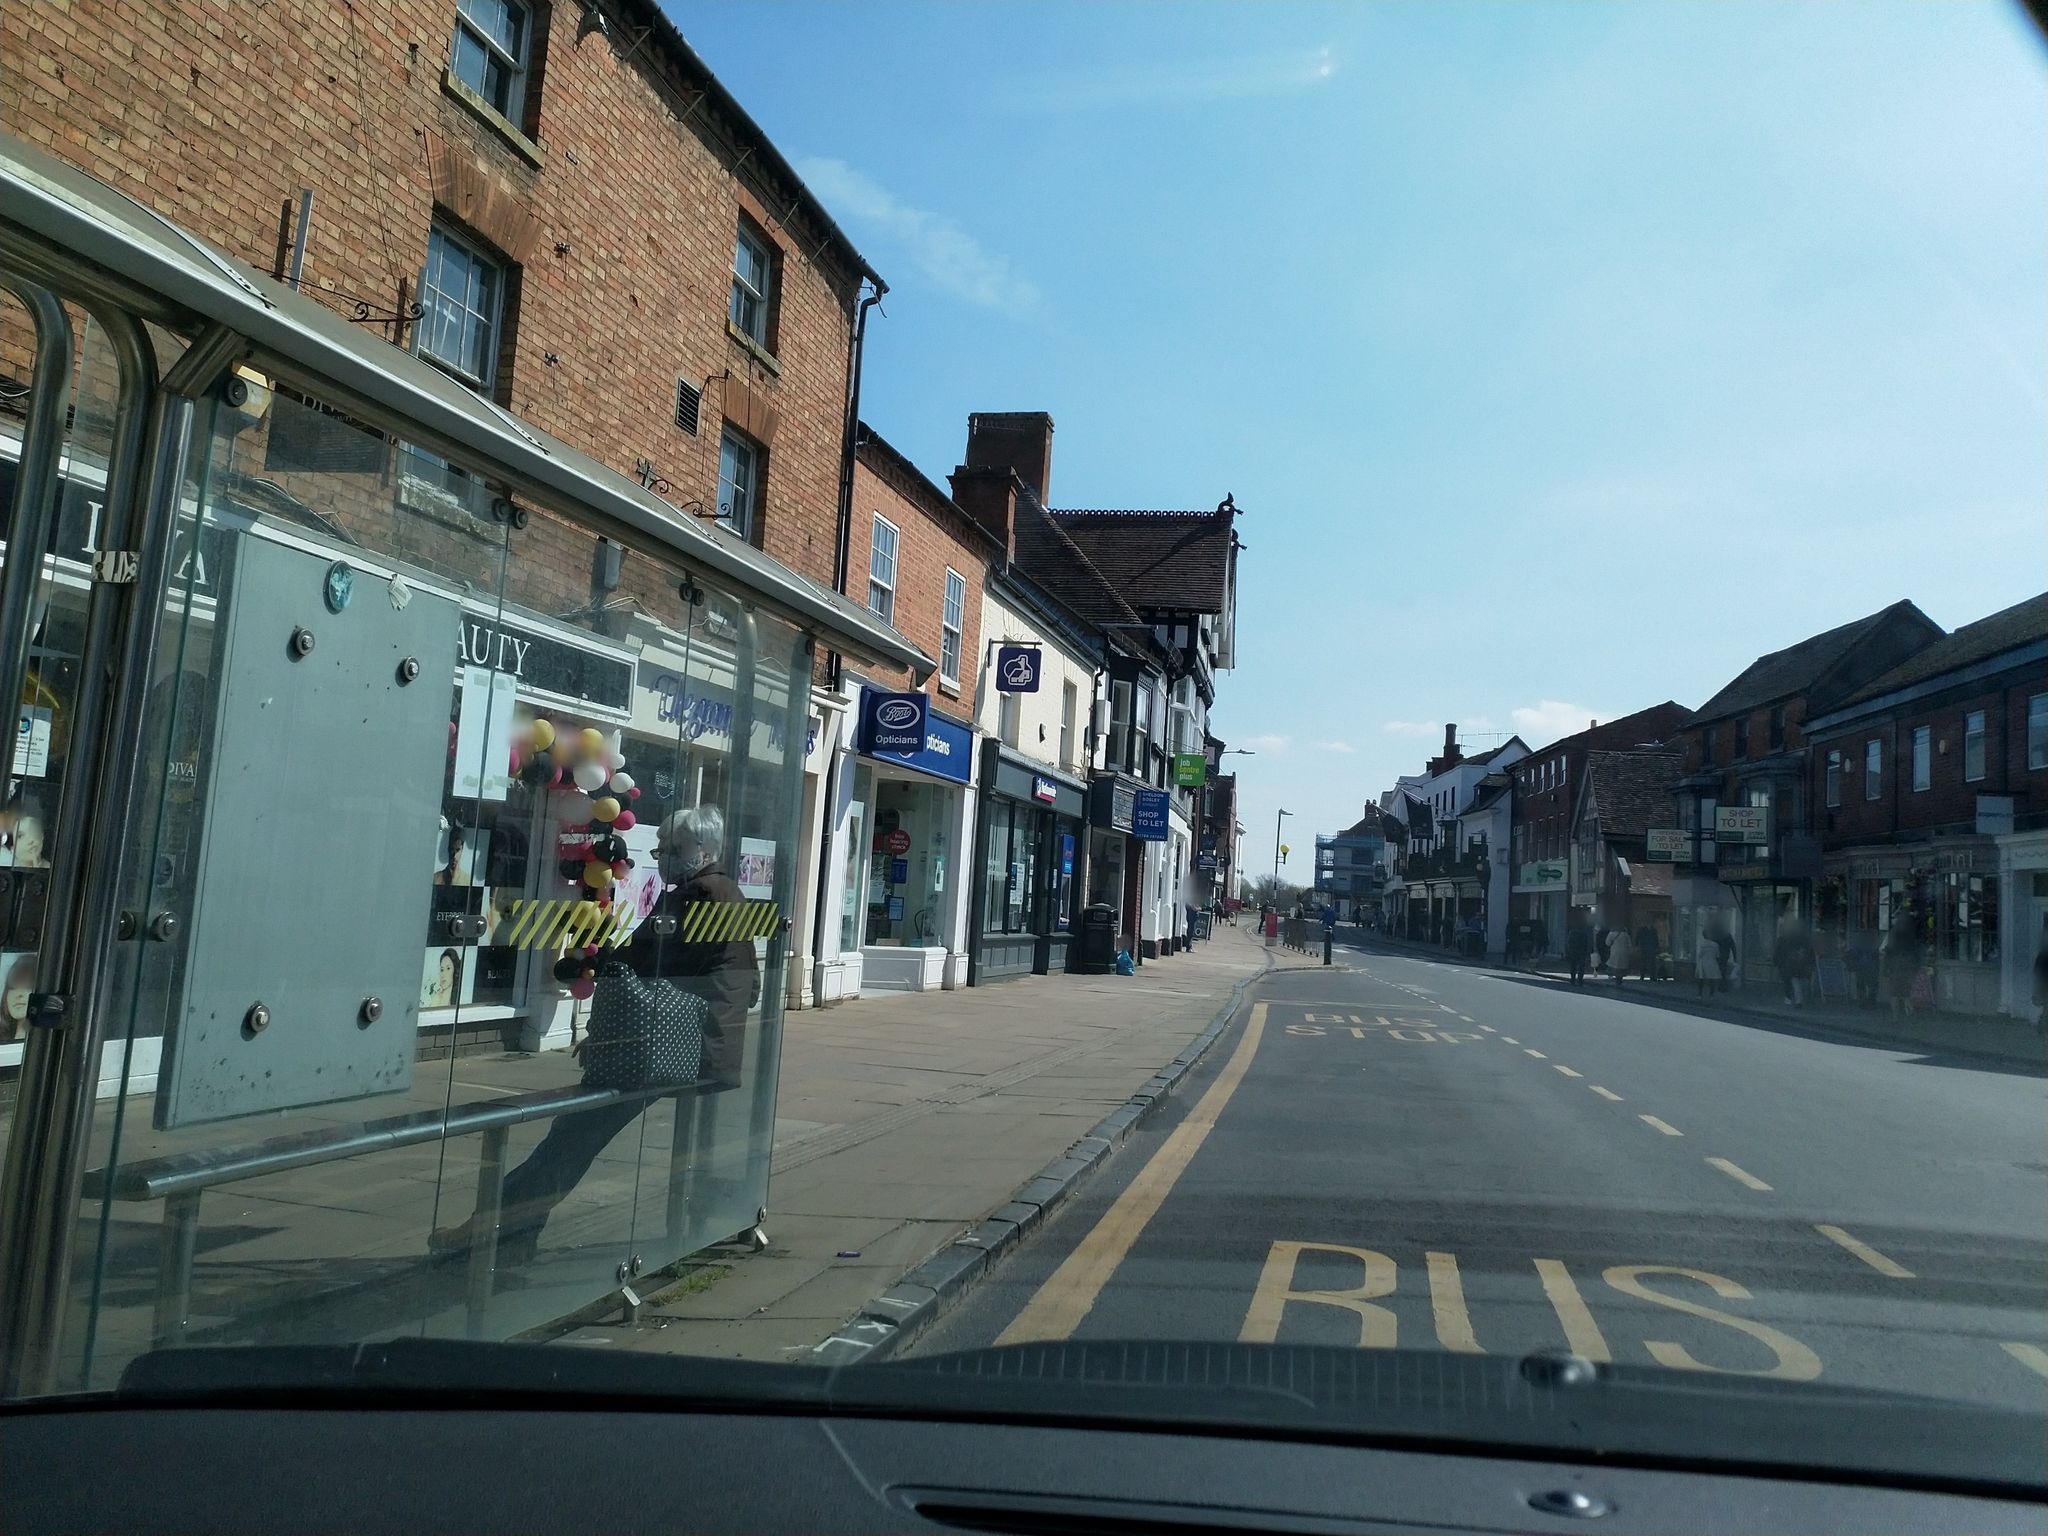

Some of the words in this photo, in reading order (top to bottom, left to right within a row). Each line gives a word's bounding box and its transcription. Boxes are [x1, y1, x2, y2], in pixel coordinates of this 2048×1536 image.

[882, 706, 912, 722] Boots
[875, 734, 918, 745] Opticians
[1729, 809, 1753, 817] SHOP
[1721, 819, 1737, 828] TO
[1741, 819, 1763, 828] LET
[1304, 1013, 1438, 1028] BUS
[1285, 1024, 1485, 1044] STOP
[1237, 1240, 1824, 1381] BUS
